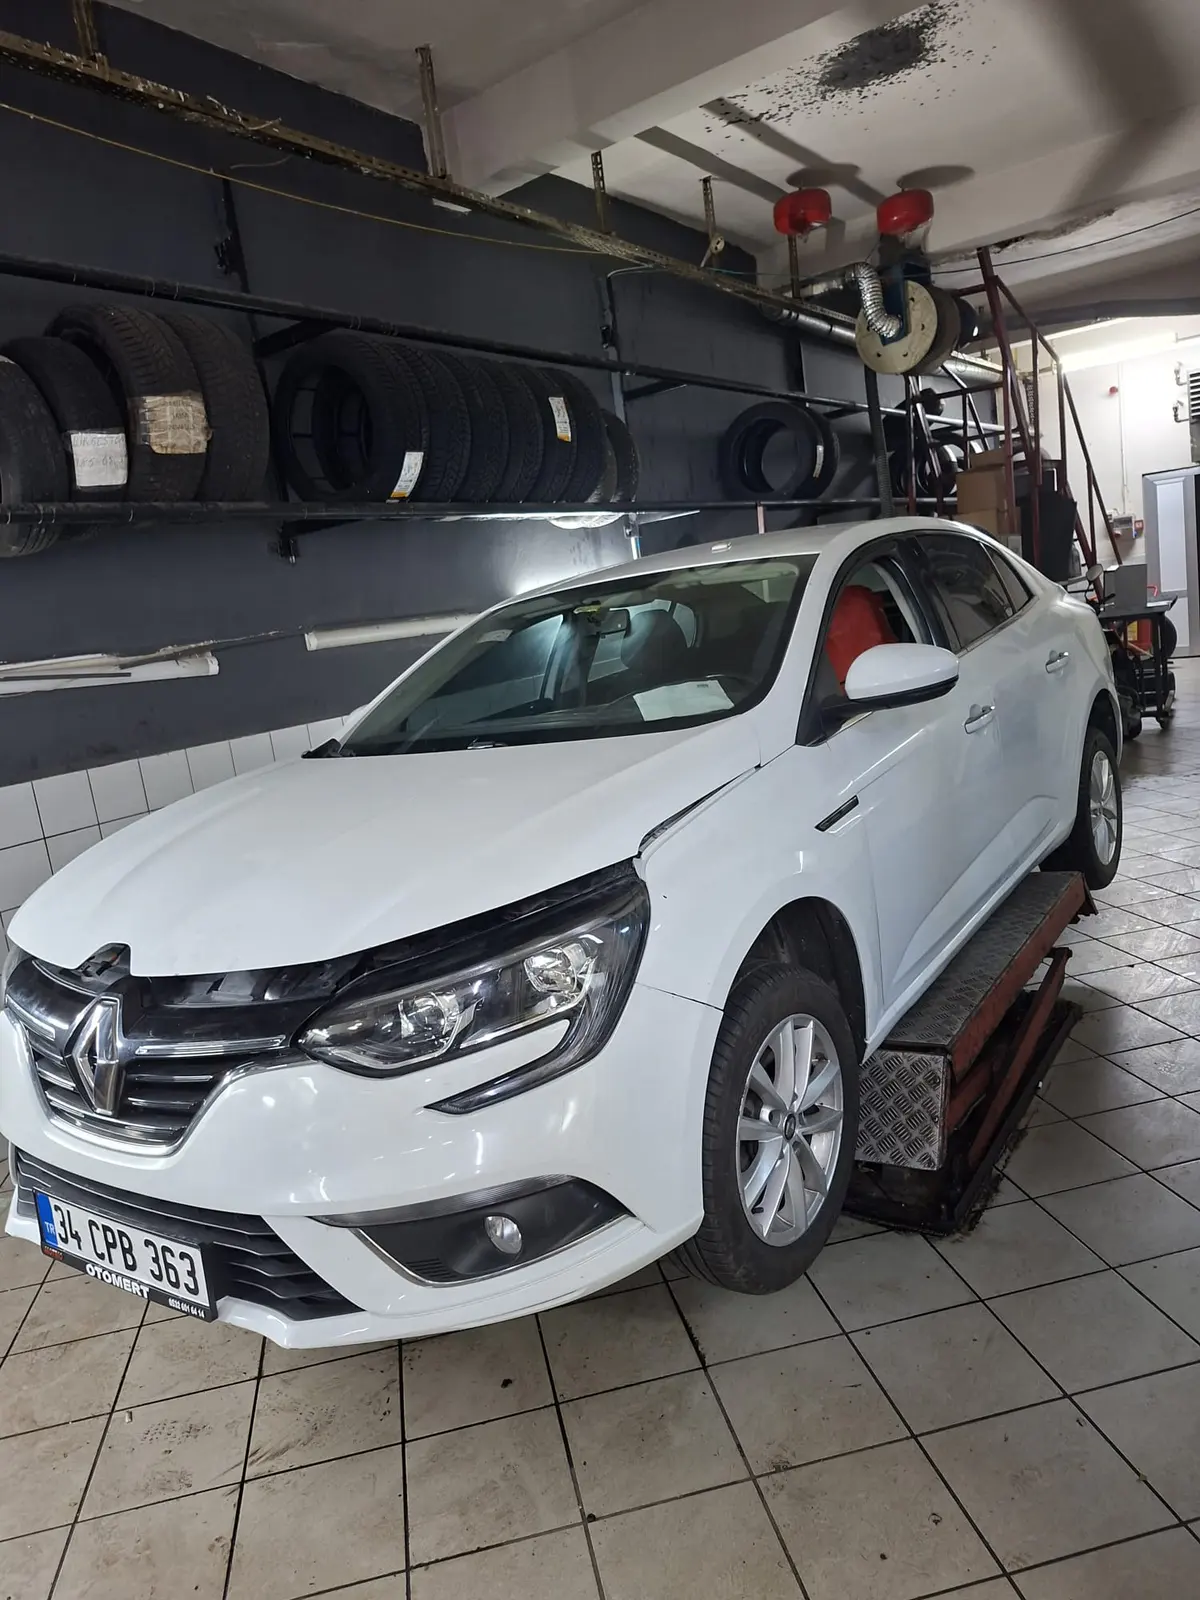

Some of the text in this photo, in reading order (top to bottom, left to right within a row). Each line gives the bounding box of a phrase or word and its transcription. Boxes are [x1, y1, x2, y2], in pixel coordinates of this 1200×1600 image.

[44, 1221, 56, 1235] TR
[54, 1204, 200, 1296] 34 CPB 363
[85, 1263, 150, 1299] OTOMERT
